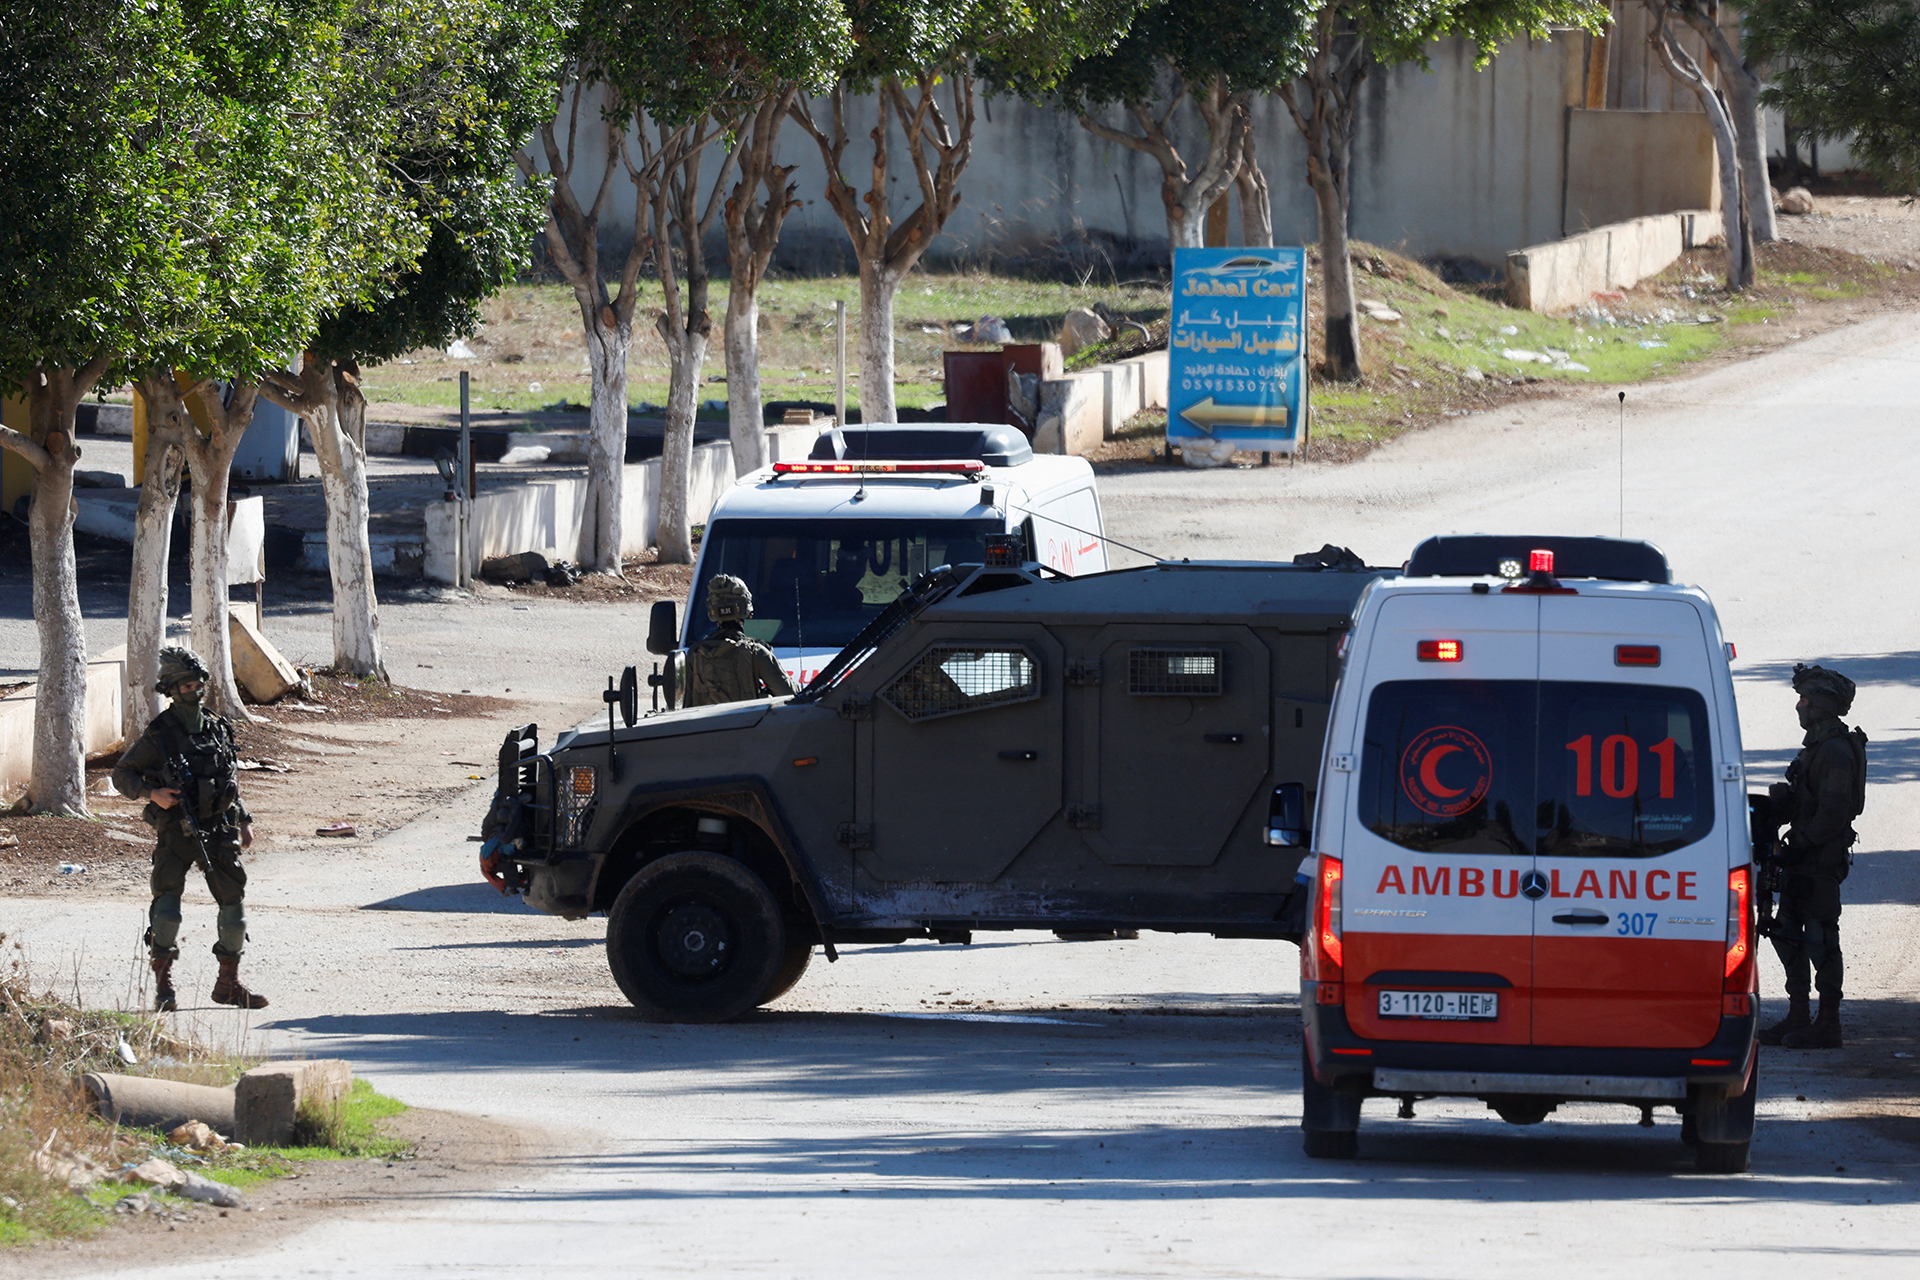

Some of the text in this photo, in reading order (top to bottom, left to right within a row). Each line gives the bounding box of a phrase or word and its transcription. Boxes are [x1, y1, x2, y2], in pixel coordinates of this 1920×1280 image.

[1182, 278, 1297, 297] Jabal Car
[1173, 329, 1242, 354] السيارات
[1567, 735, 1675, 798] 101
[1376, 865, 1697, 901] AMBULANCE
[1353, 908, 1428, 918] SPRINTER
[1617, 912, 1658, 936] 307
